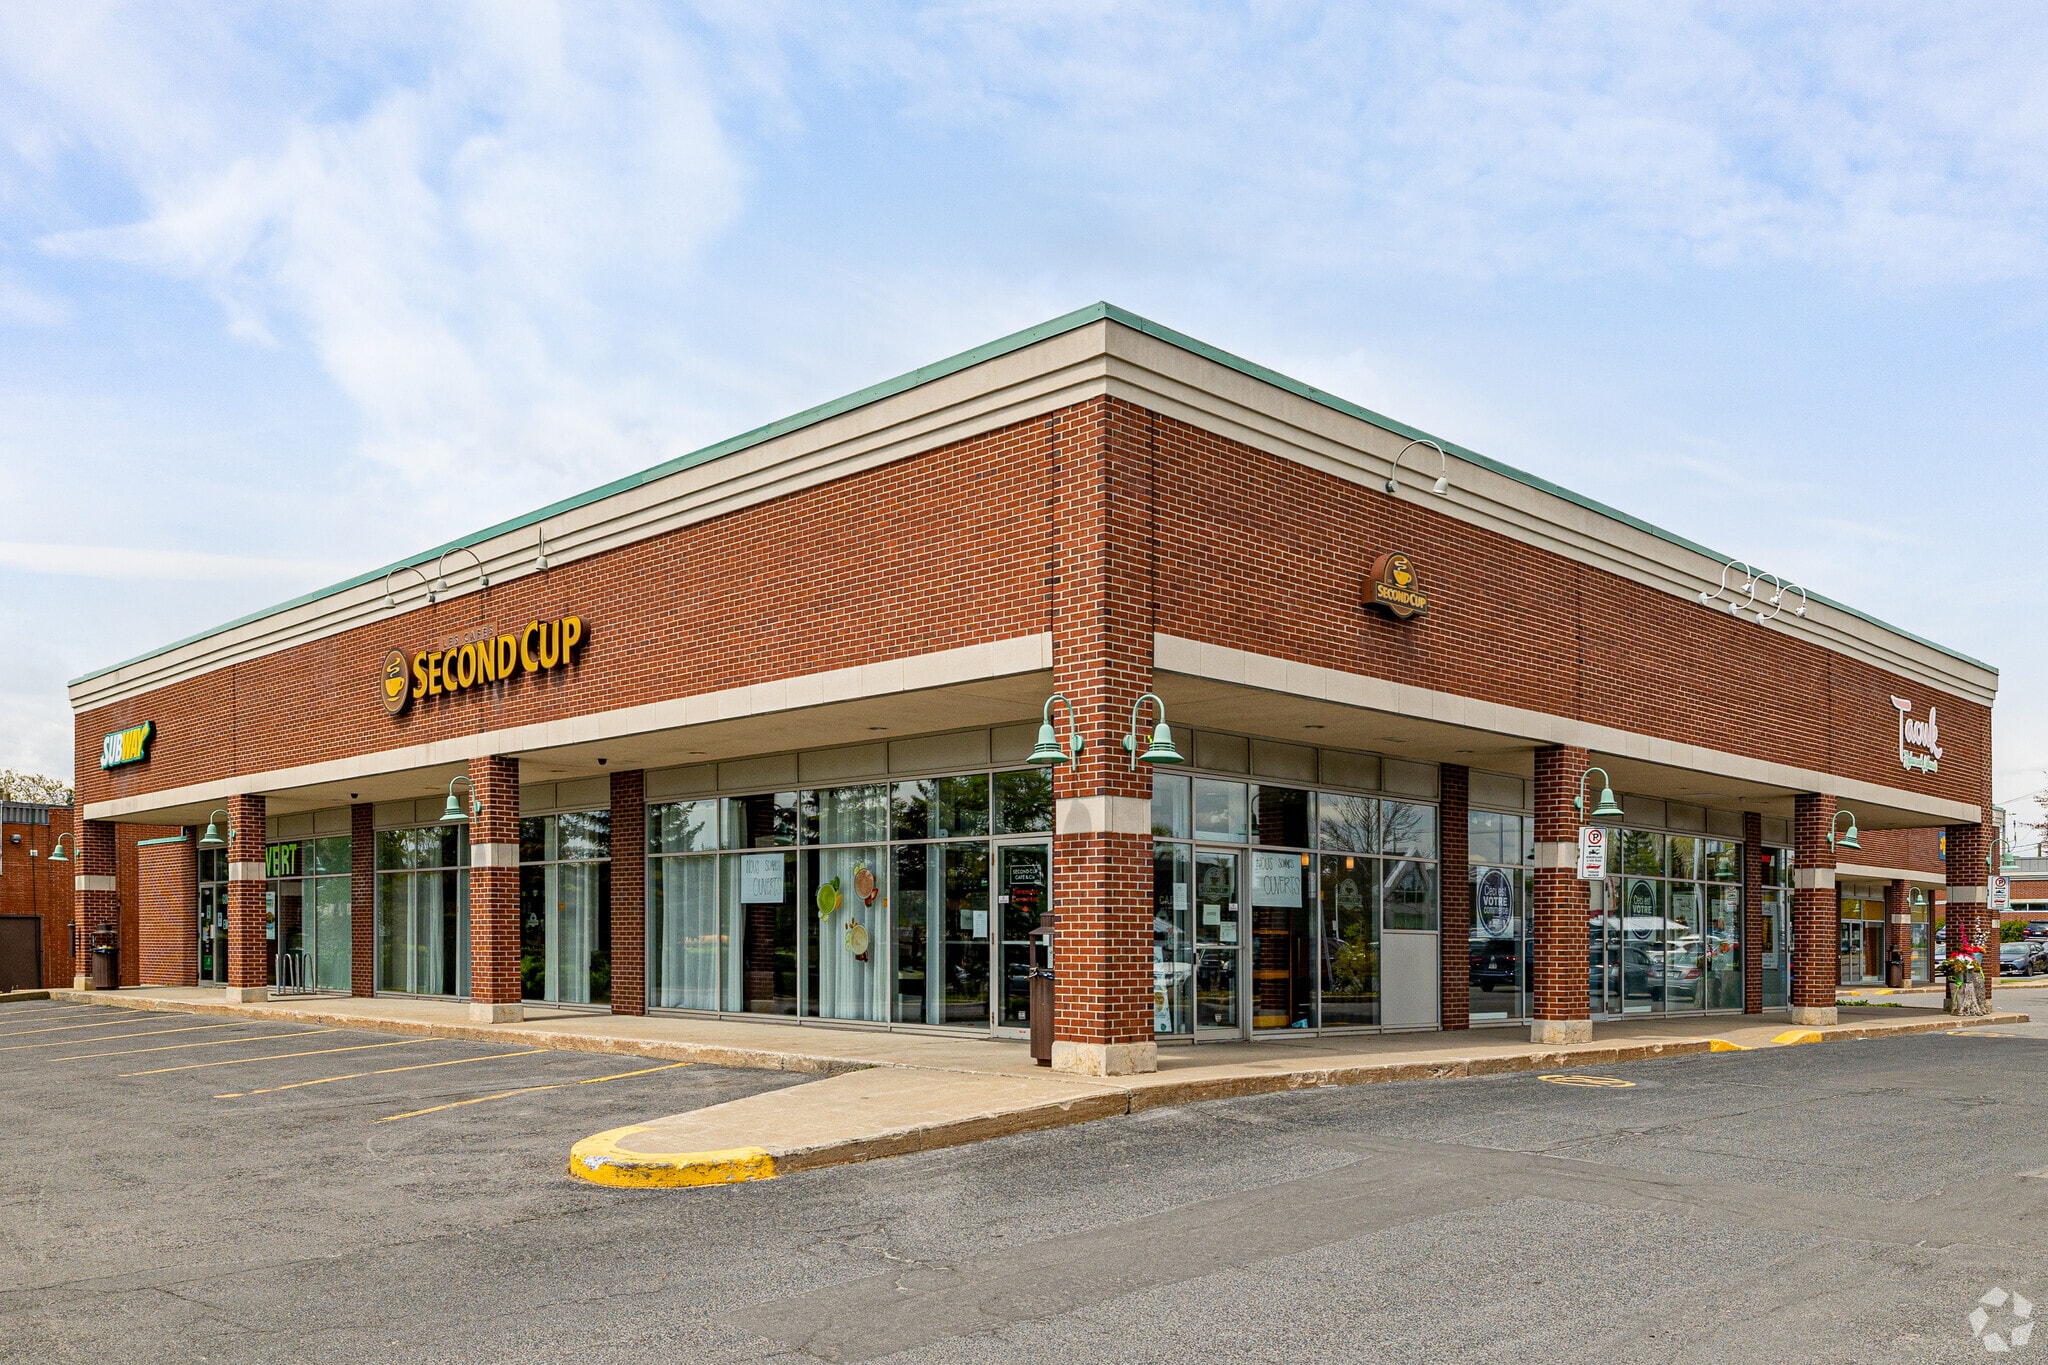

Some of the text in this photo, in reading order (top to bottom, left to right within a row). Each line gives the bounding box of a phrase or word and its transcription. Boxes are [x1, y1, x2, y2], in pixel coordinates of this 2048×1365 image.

[1378, 585, 1426, 608] SECOND CUP
[442, 634, 459, 648] LES
[413, 615, 582, 699] SECOND CUP
[1890, 695, 1943, 764] Taouk
[100, 720, 150, 770] SUBWAY
[1263, 875, 1300, 896] OUVERTS
[1484, 884, 1498, 897] Ceci
[1482, 896, 1508, 907] VOTRE
[1632, 904, 1652, 914] VOTRE
